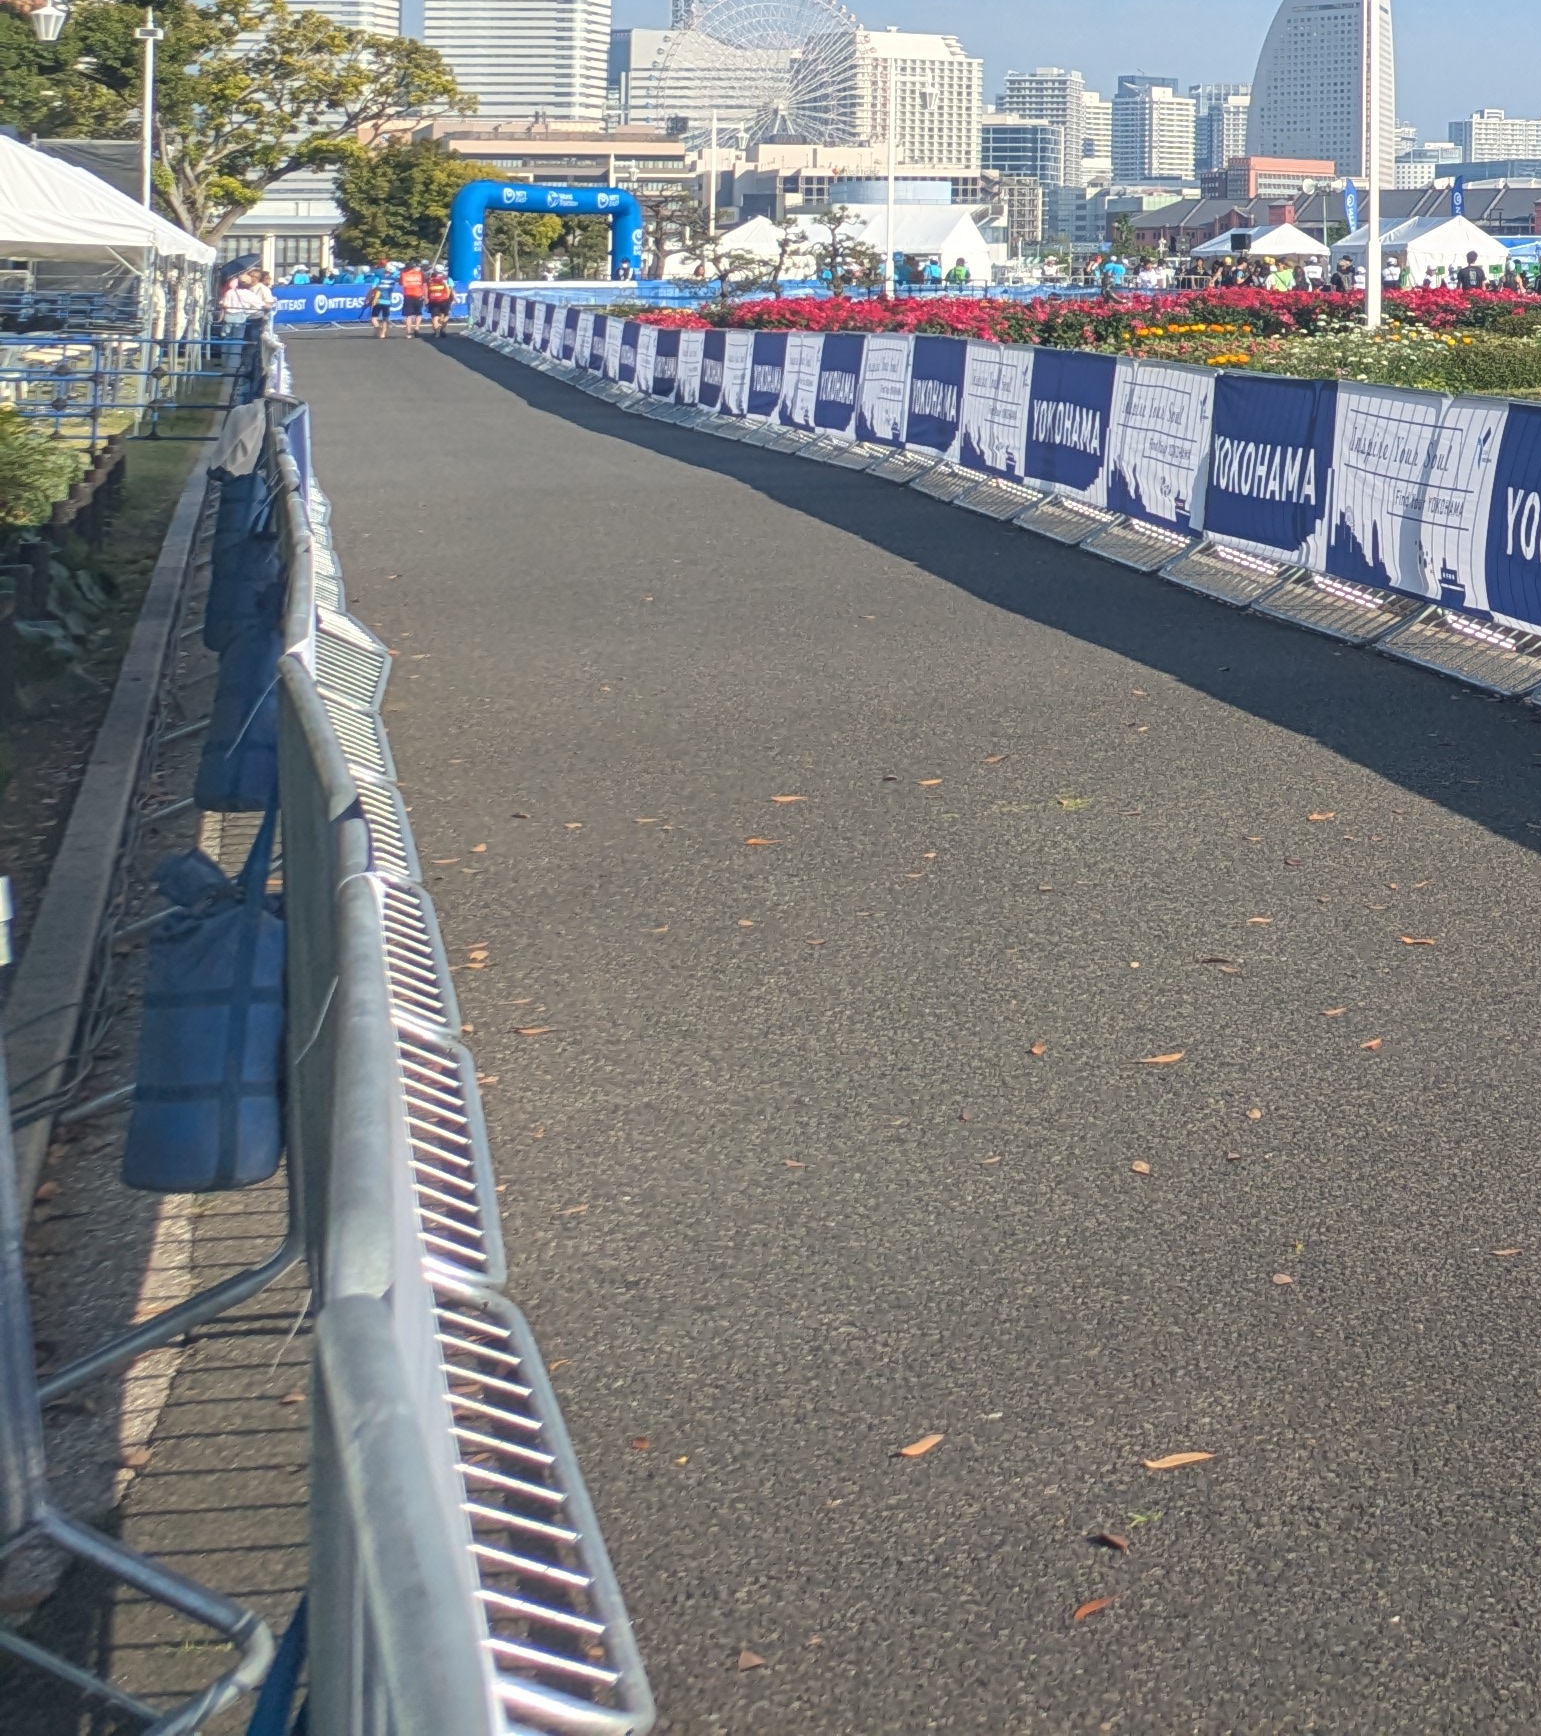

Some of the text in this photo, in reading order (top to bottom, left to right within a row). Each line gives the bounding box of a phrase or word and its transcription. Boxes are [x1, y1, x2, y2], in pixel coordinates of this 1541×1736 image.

[289, 298, 307, 311] EAST
[345, 296, 366, 309] EAS
[911, 378, 958, 424] YOKOHAMA
[1033, 400, 1101, 455] YOKOHAMA
[1350, 426, 1389, 464] Inspire
[1393, 436, 1419, 467] Your
[1424, 441, 1453, 472] Soul
[1212, 433, 1317, 506] YOKOHAMA
